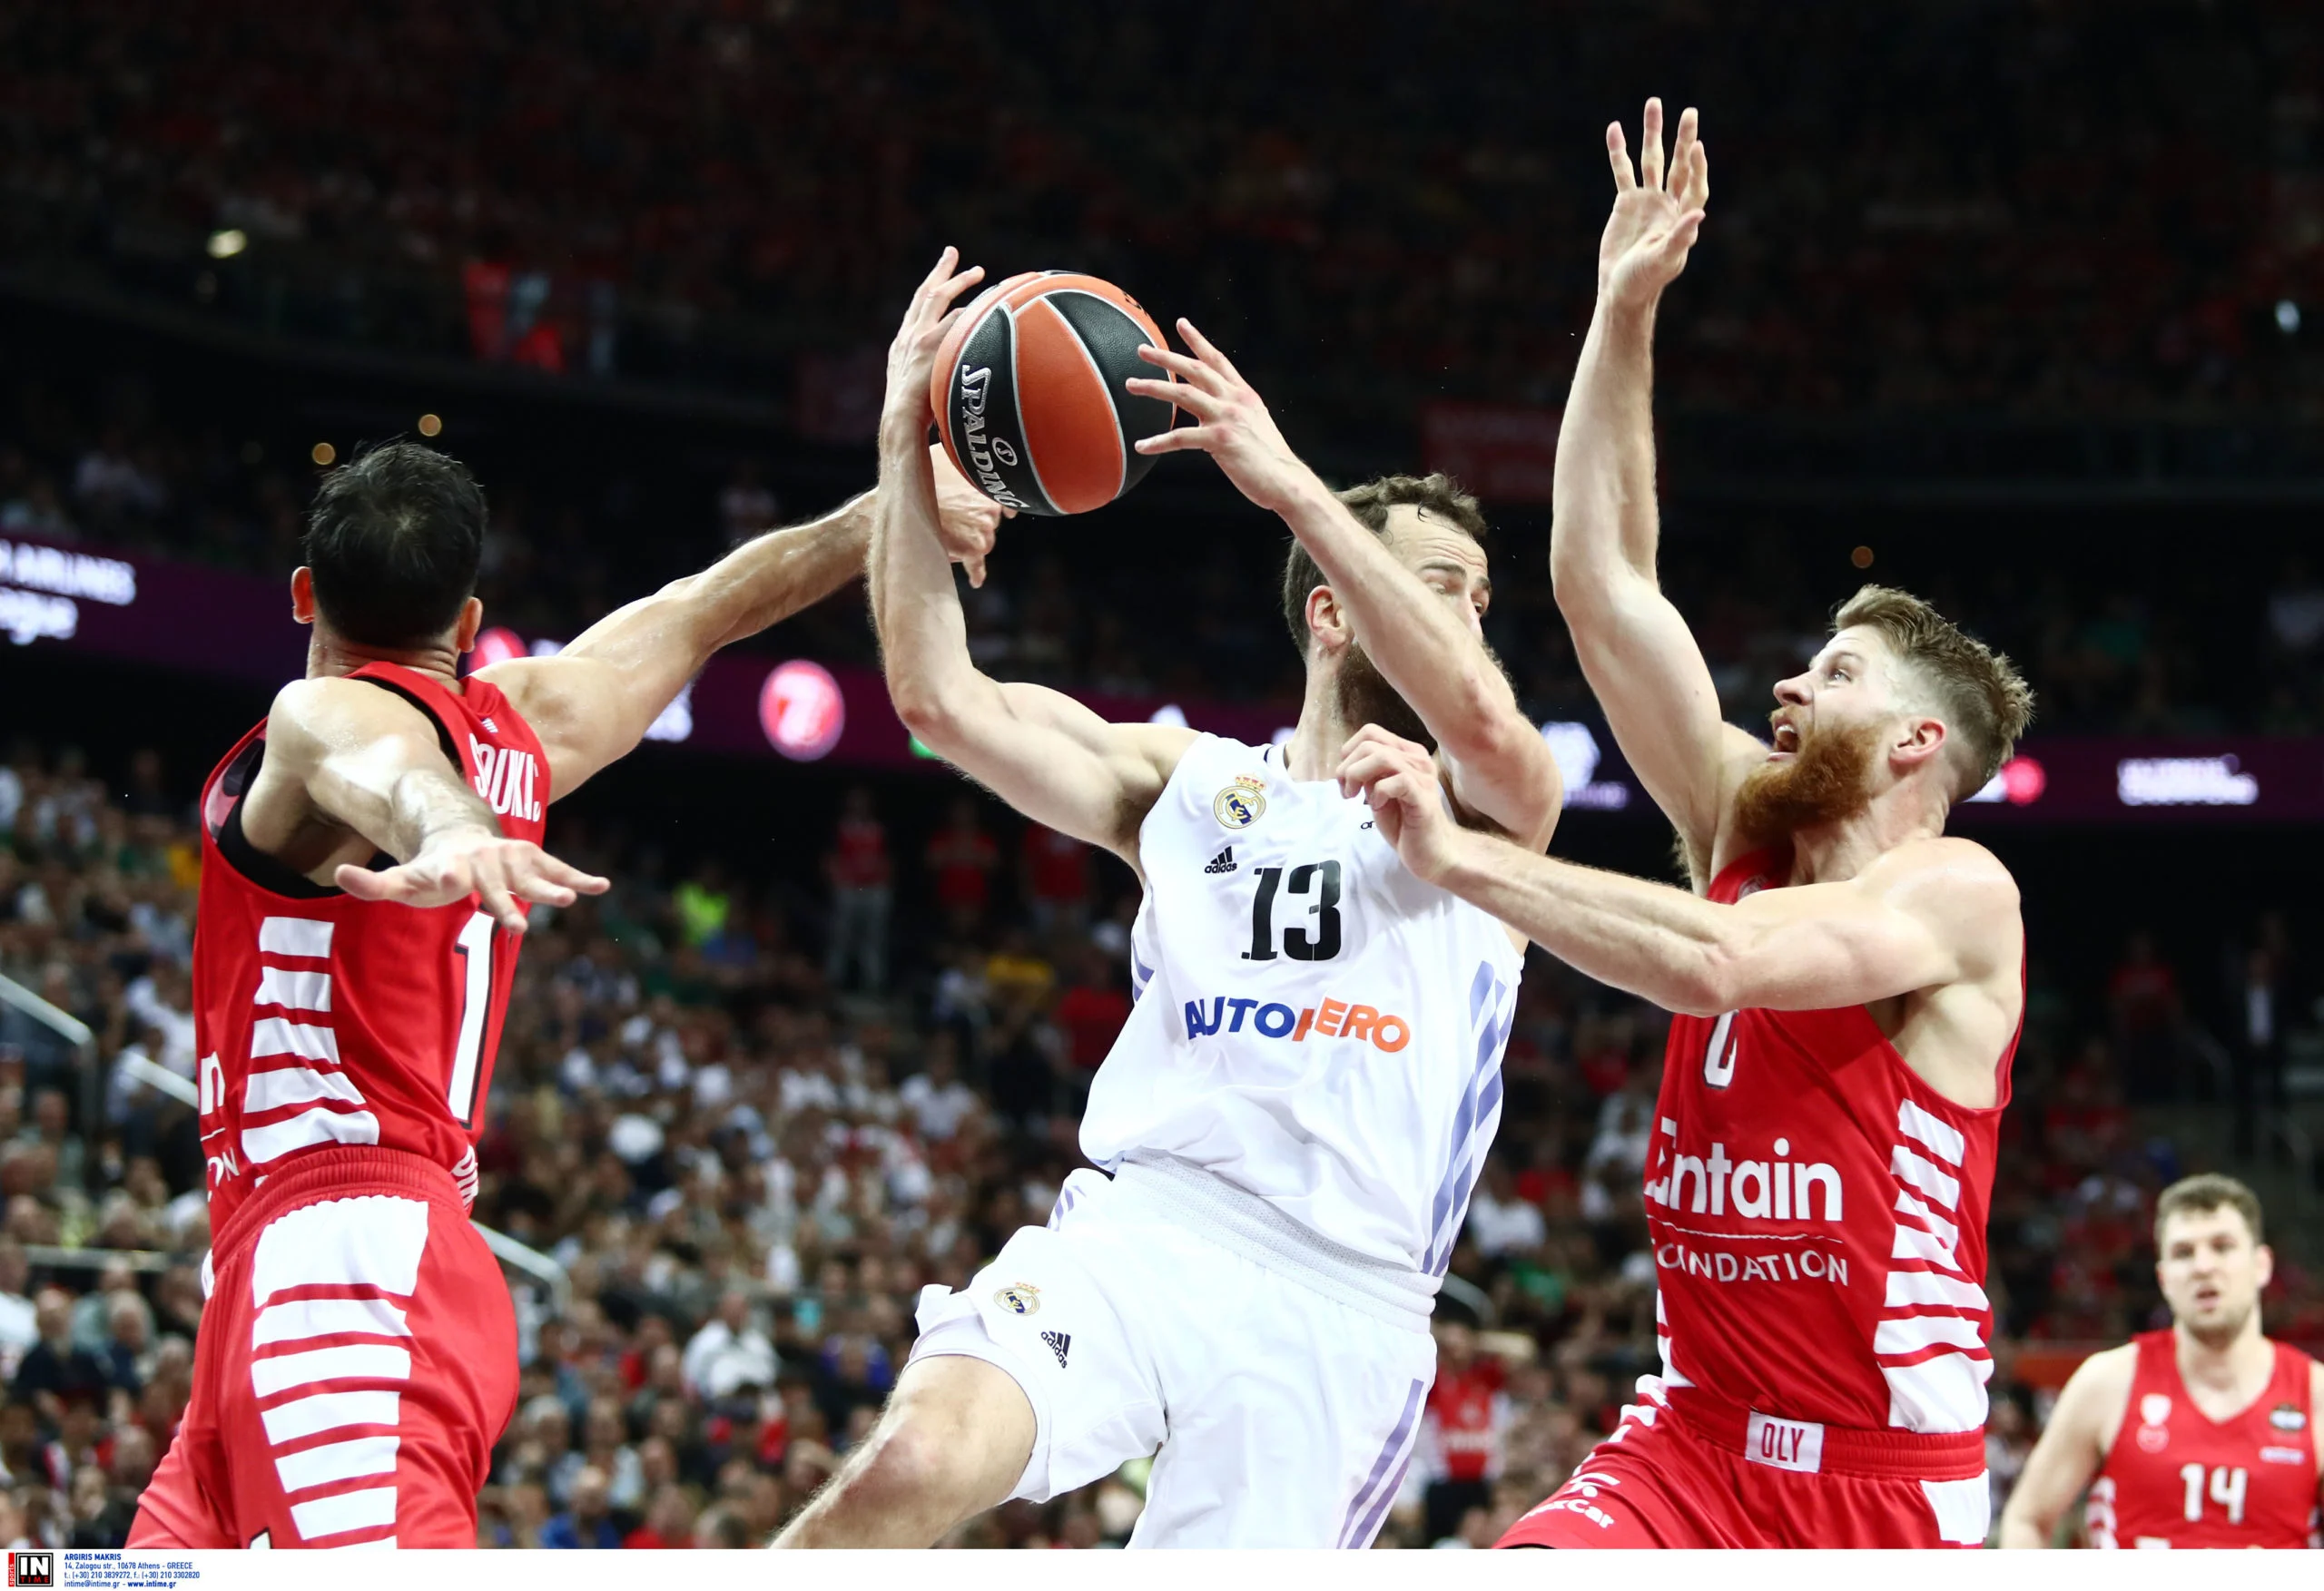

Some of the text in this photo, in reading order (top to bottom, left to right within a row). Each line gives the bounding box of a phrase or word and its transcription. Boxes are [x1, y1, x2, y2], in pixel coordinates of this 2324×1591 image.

[960, 364, 1031, 508] SPALDING
[1204, 862, 1237, 874] adidas
[1241, 859, 1342, 961] 13
[1040, 1331, 1068, 1369] adidas
[1761, 1421, 1806, 1464] OLY
[2180, 1461, 2249, 1526] 14
